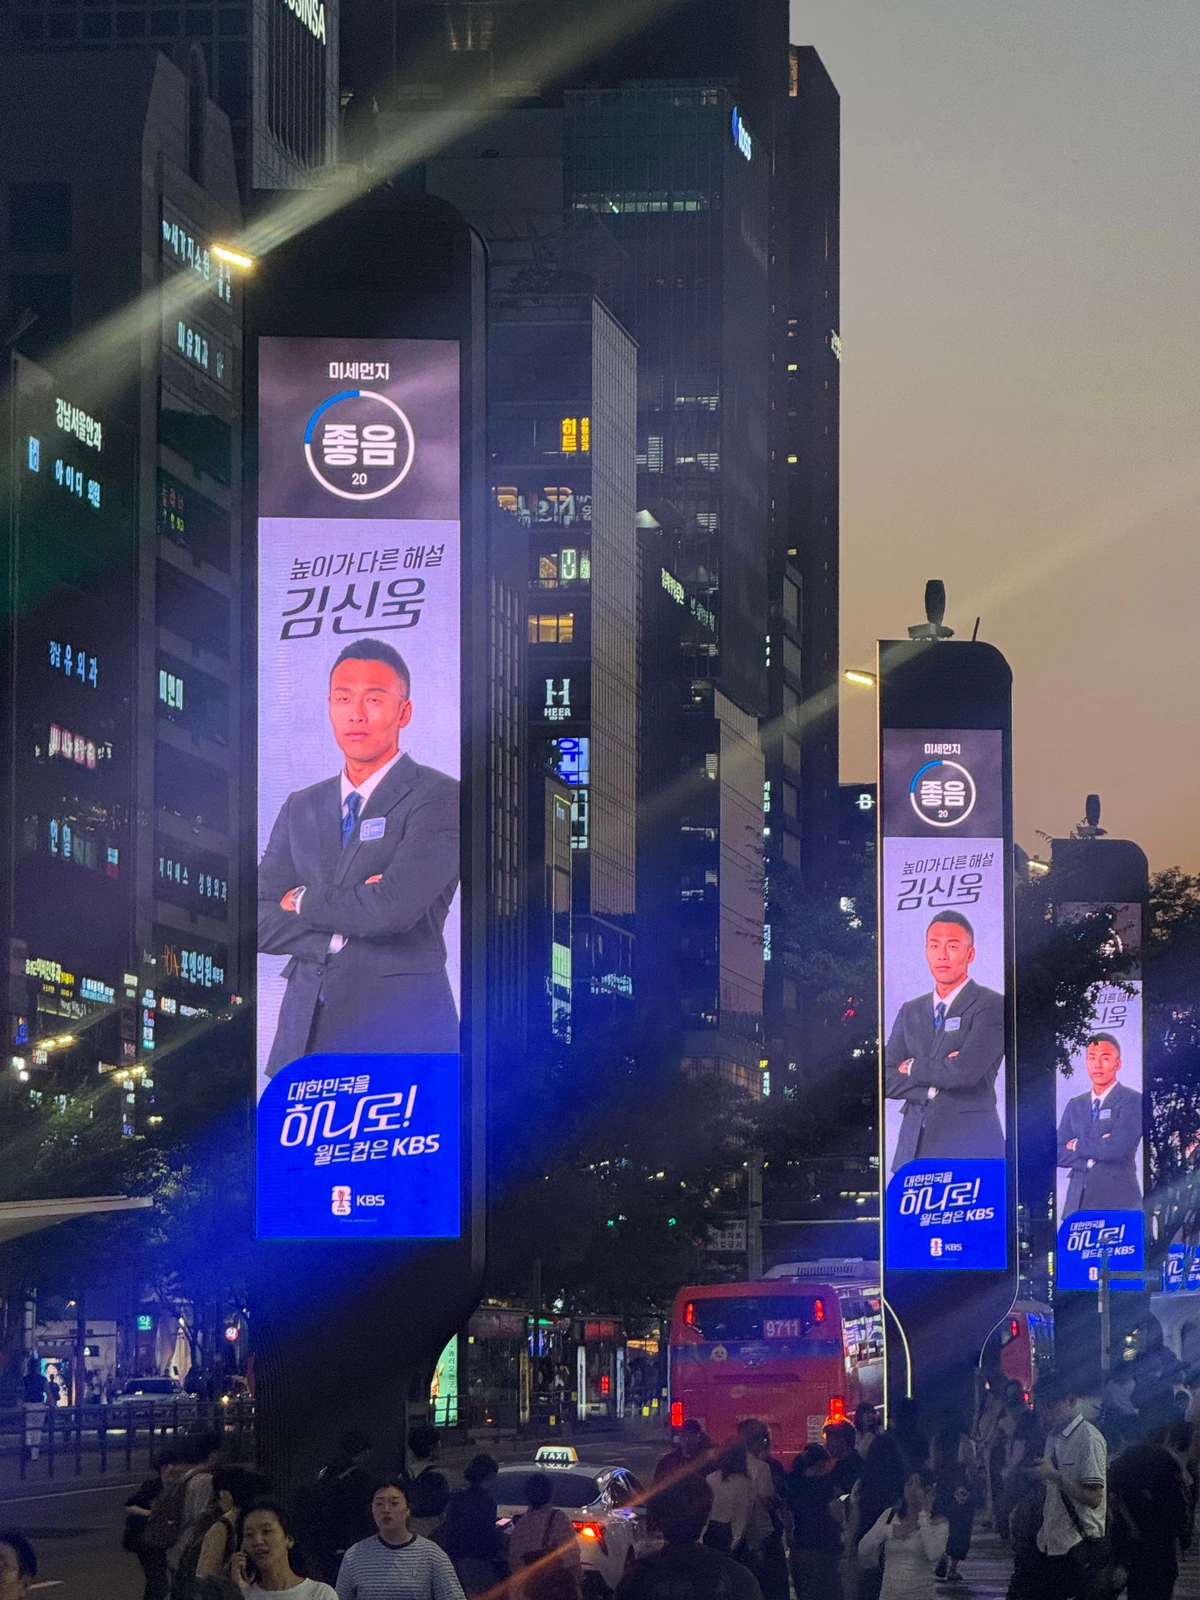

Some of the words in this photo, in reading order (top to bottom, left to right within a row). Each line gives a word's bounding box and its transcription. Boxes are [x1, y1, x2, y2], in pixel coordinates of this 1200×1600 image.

[329, 362, 389, 380] 미세먼지
[56, 398, 102, 452] 강남서울안과
[322, 424, 397, 465] 좋음
[56, 459, 83, 497] 아이디
[352, 473, 368, 485] 20
[290, 553, 355, 580] 높이가
[356, 548, 400, 573] 다른
[403, 544, 445, 569] 해설
[280, 578, 426, 640] 김신욱
[544, 707, 571, 717] HEER
[924, 743, 961, 755] 미세먼지
[920, 780, 965, 807] 좋음
[938, 810, 949, 818] 20
[902, 857, 941, 876] 높이가
[941, 855, 967, 870] 다른
[969, 852, 995, 869] 해설
[897, 872, 983, 911] 김신욱
[287, 1075, 370, 1101] 대한민국을
[314, 1140, 388, 1166] 월드컵은
[391, 1134, 440, 1157] KBS
[903, 1171, 953, 1188] 대한민국을
[356, 1194, 385, 1206] KBS
[920, 1210, 964, 1227] 월드컵은
[965, 1207, 995, 1221] KBS
[945, 1243, 963, 1251] KBS
[1114, 1245, 1135, 1256] KBS
[766, 1320, 799, 1337] 9711
[542, 1452, 568, 1461] TAXI
